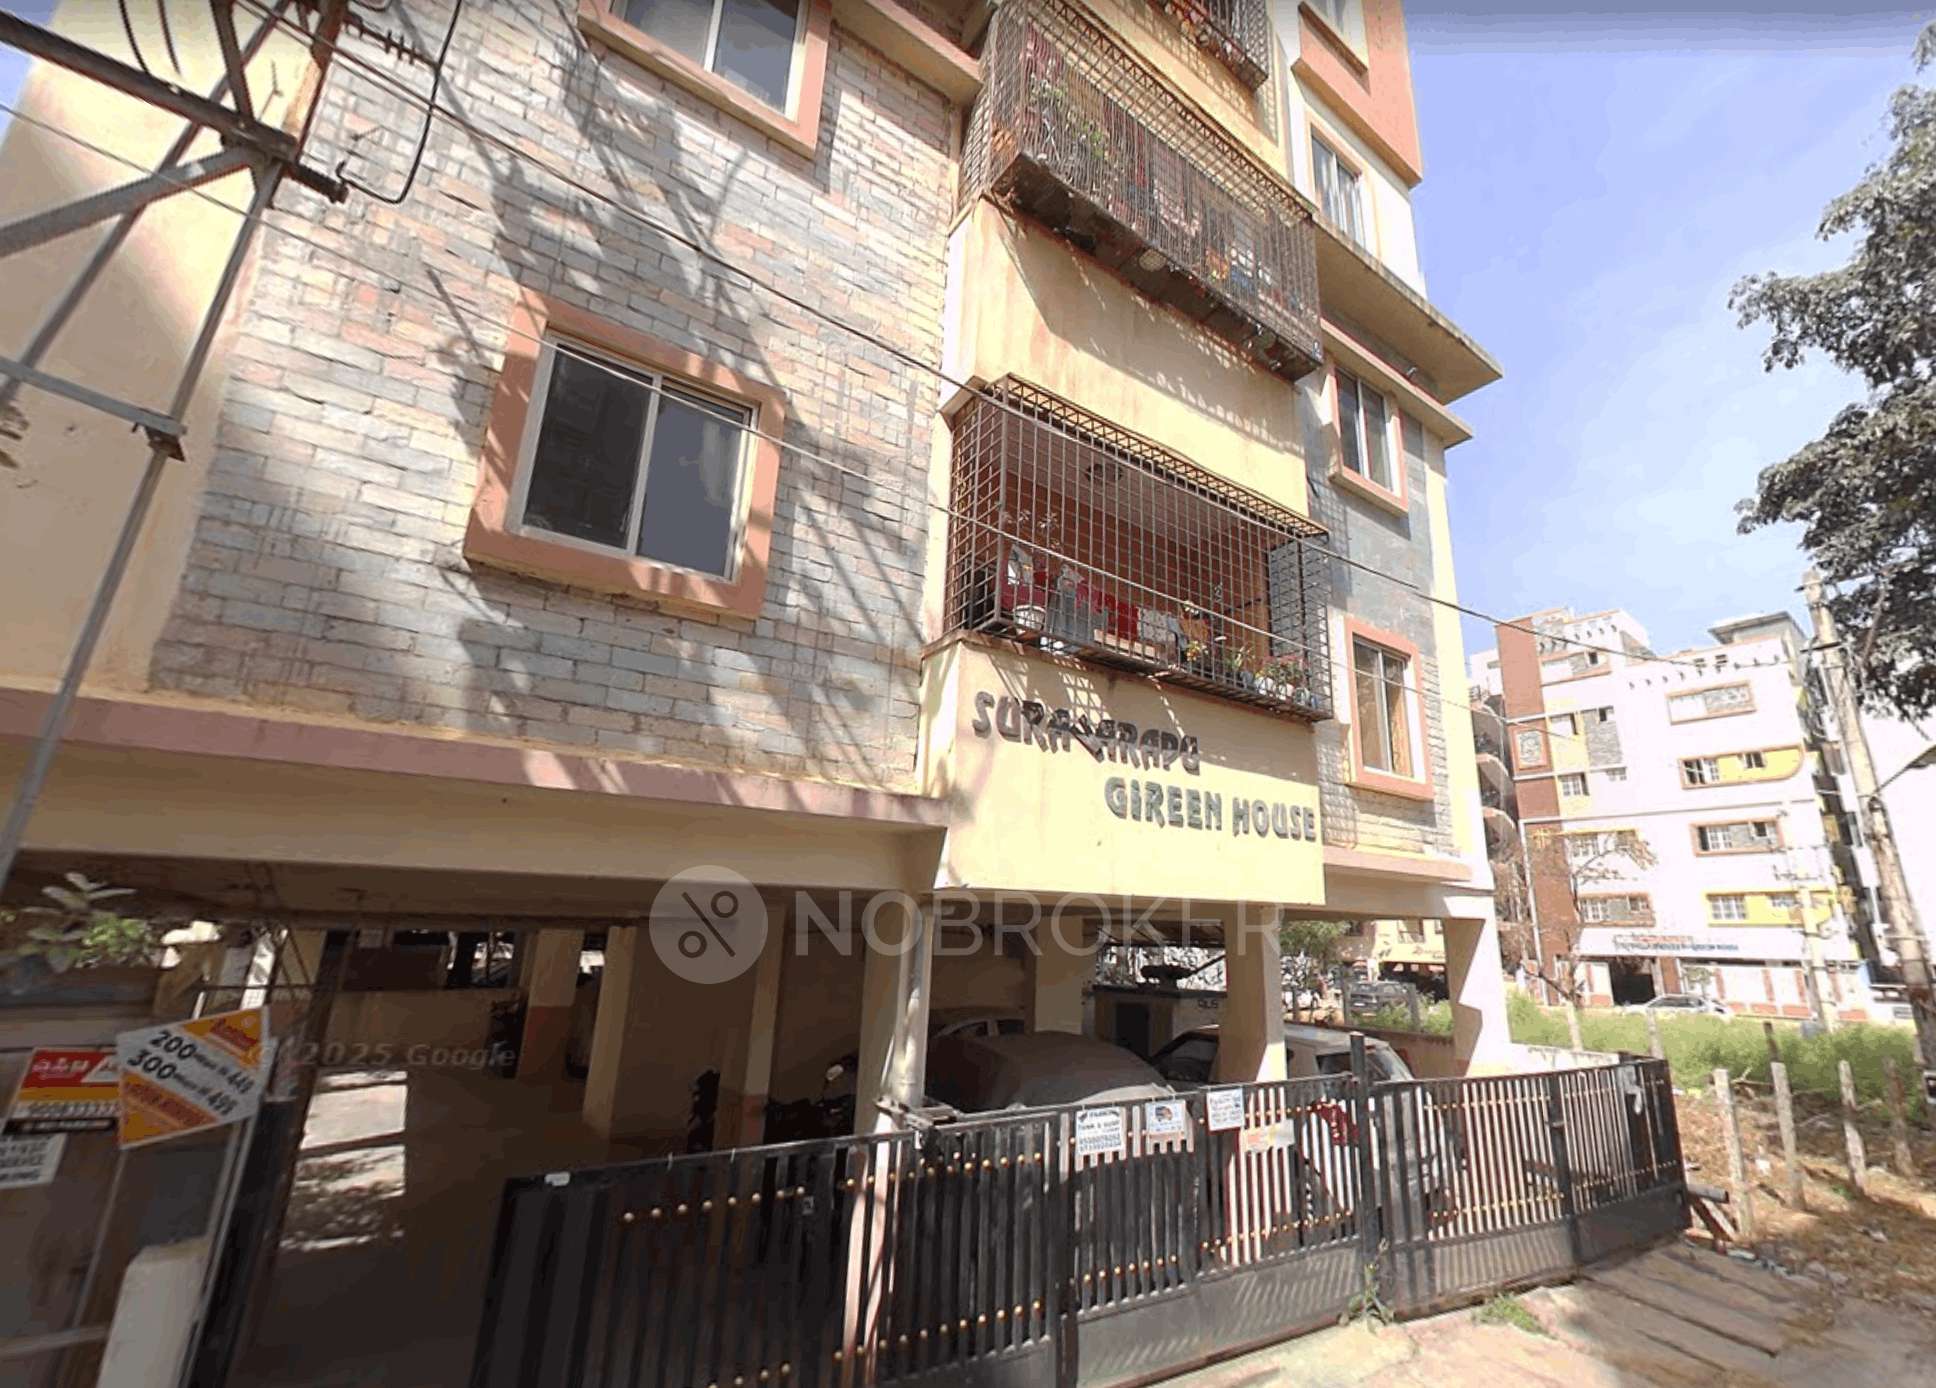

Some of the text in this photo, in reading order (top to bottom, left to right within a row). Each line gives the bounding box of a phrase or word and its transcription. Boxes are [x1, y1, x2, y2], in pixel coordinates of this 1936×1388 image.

[1232, 797, 1316, 842] HOUSE
[150, 1030, 196, 1059] 200
[127, 1050, 176, 1079] 300
